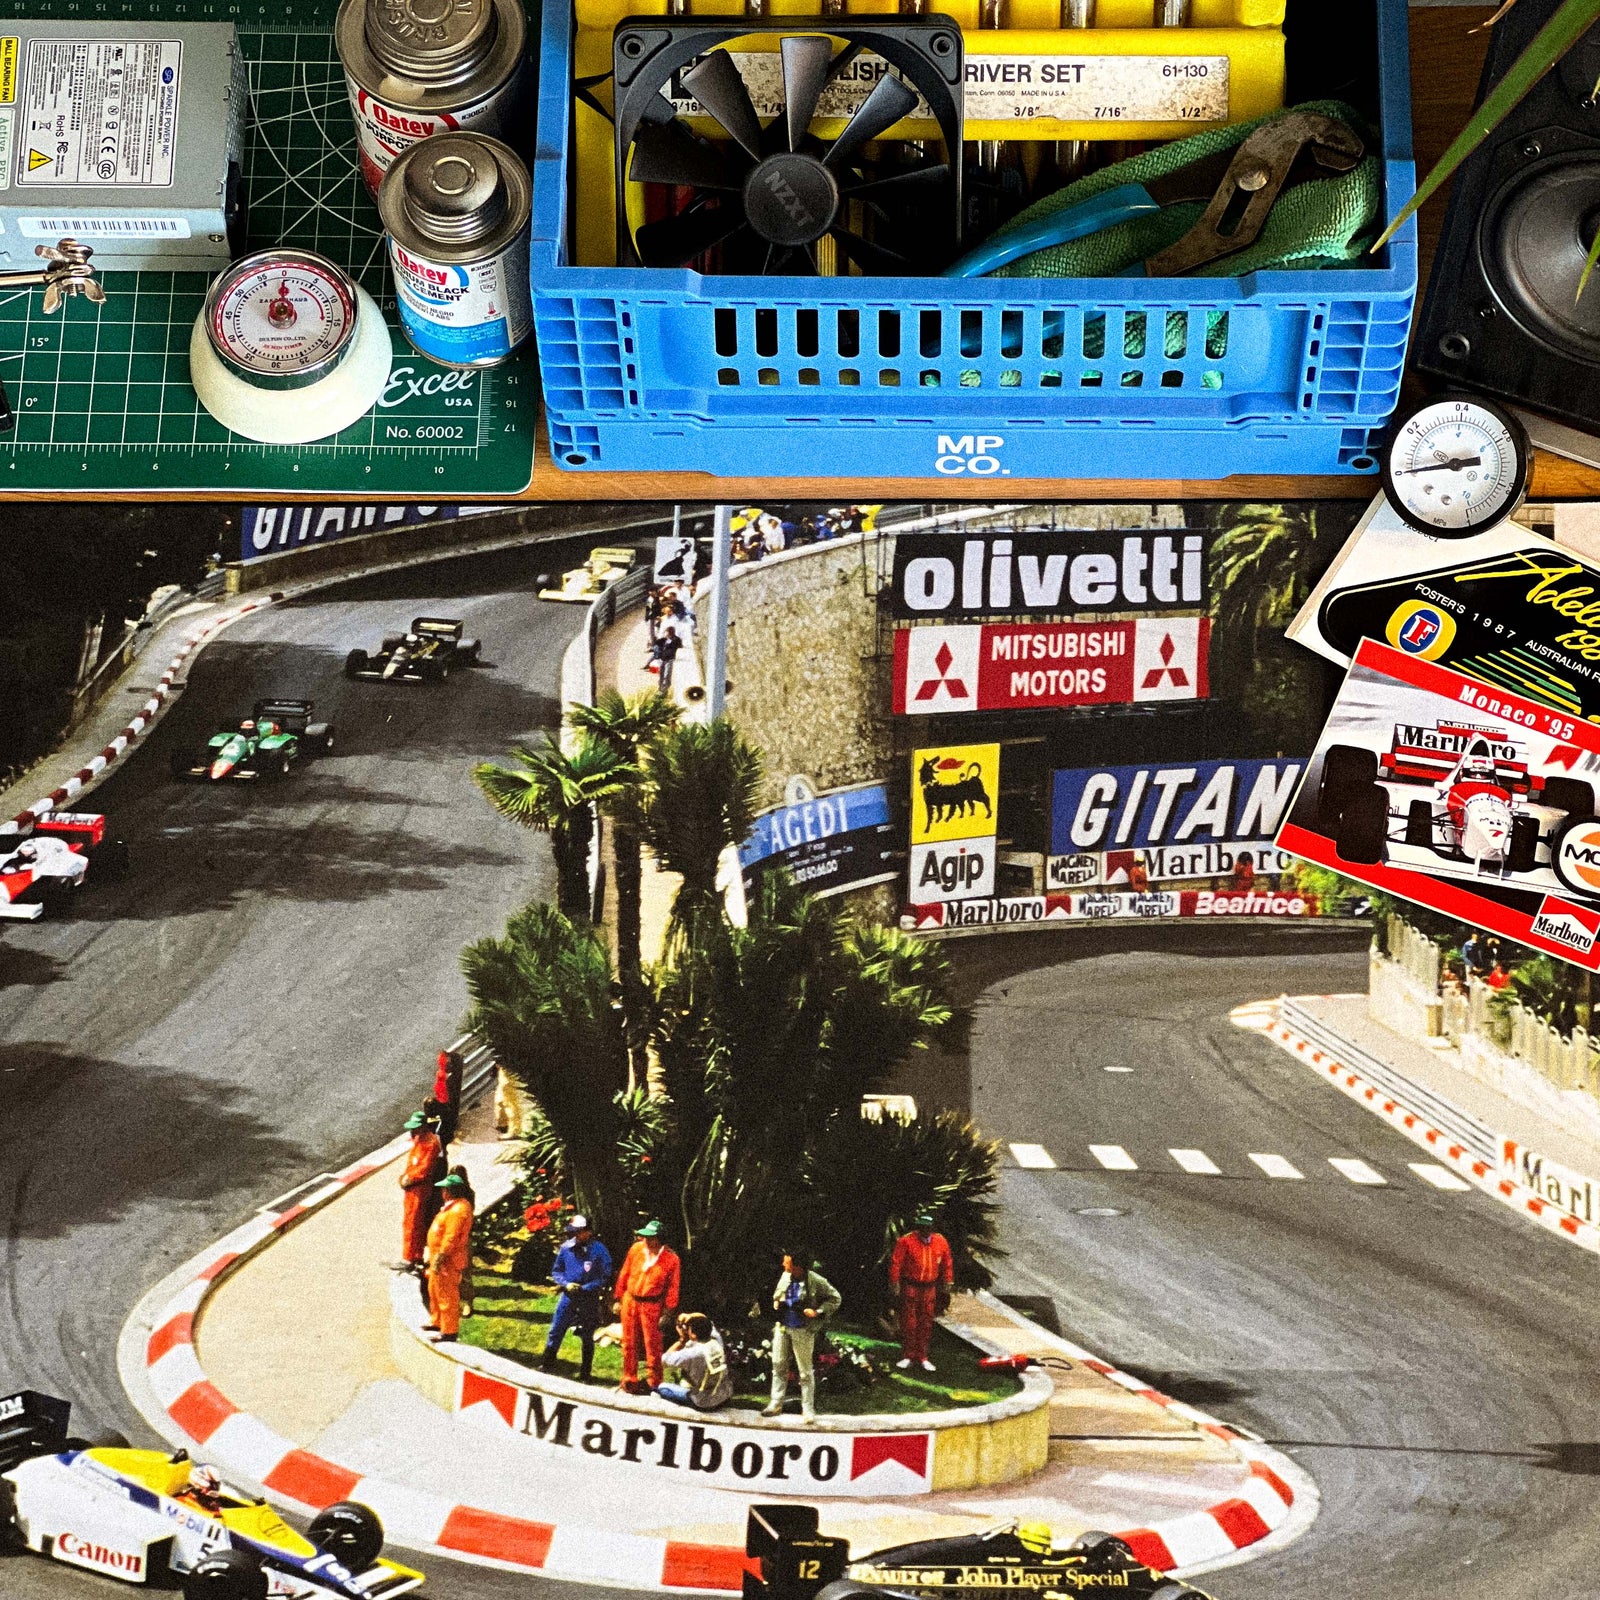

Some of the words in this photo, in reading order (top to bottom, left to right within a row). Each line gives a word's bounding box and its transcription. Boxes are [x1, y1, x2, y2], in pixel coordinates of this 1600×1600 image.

[5, 39, 13, 55] BALL
[3, 57, 12, 86] BEARING
[838, 62, 890, 81] LISH
[964, 63, 1032, 83] RIVER
[1040, 63, 1086, 83] SET
[1162, 64, 1208, 78] 61-130
[2, 87, 11, 101] FAN
[164, 86, 174, 117] SPARKLE
[373, 104, 434, 137] Oatey
[1014, 106, 1040, 117] 3/8"
[1094, 107, 1127, 118] 7/16"
[1181, 107, 1206, 118] 1/2"
[55, 115, 66, 137] RoHS
[163, 118, 172, 144] POWER
[764, 171, 814, 227] NZXT
[398, 248, 447, 286] Oatey
[413, 284, 462, 301] CEMENT
[428, 283, 470, 295] BLACK
[30, 337, 49, 347] 15°
[271, 361, 282, 369] 30
[377, 367, 476, 408] Excel
[445, 398, 473, 407] USA
[386, 425, 412, 439] No.
[416, 426, 464, 439] 60002
[1407, 421, 1420, 435] 0.2
[937, 435, 1004, 454] MP
[434, 466, 444, 474] 10
[934, 455, 1011, 474] CO.
[904, 536, 1202, 610] olivetti
[1402, 614, 1437, 648] F
[1415, 582, 1466, 614] FOSTER'S
[1525, 639, 1591, 677] AUSTRALIAN
[991, 631, 1125, 661] MITSUBISHI
[1010, 668, 1106, 697] MOTORS
[1458, 684, 1538, 727] Monaco
[1543, 715, 1575, 740] '95
[1402, 726, 1516, 761] Marlro
[1070, 764, 1300, 847] GITAN
[919, 848, 985, 892] Agip
[1143, 845, 1292, 880] Marlbro
[944, 900, 1043, 927] Marlboro
[1195, 892, 1304, 915] Beatrice
[1535, 915, 1592, 948] Marlboro
[1522, 1150, 1600, 1232] Marl
[521, 1392, 840, 1482] Marlboro
[166, 1504, 205, 1534] Mobil
[59, 1532, 142, 1573] Canon
[799, 1560, 821, 1579] 12
[956, 1567, 1002, 1586] John
[1005, 1568, 1062, 1591] Player
[1066, 1569, 1129, 1590] Special
